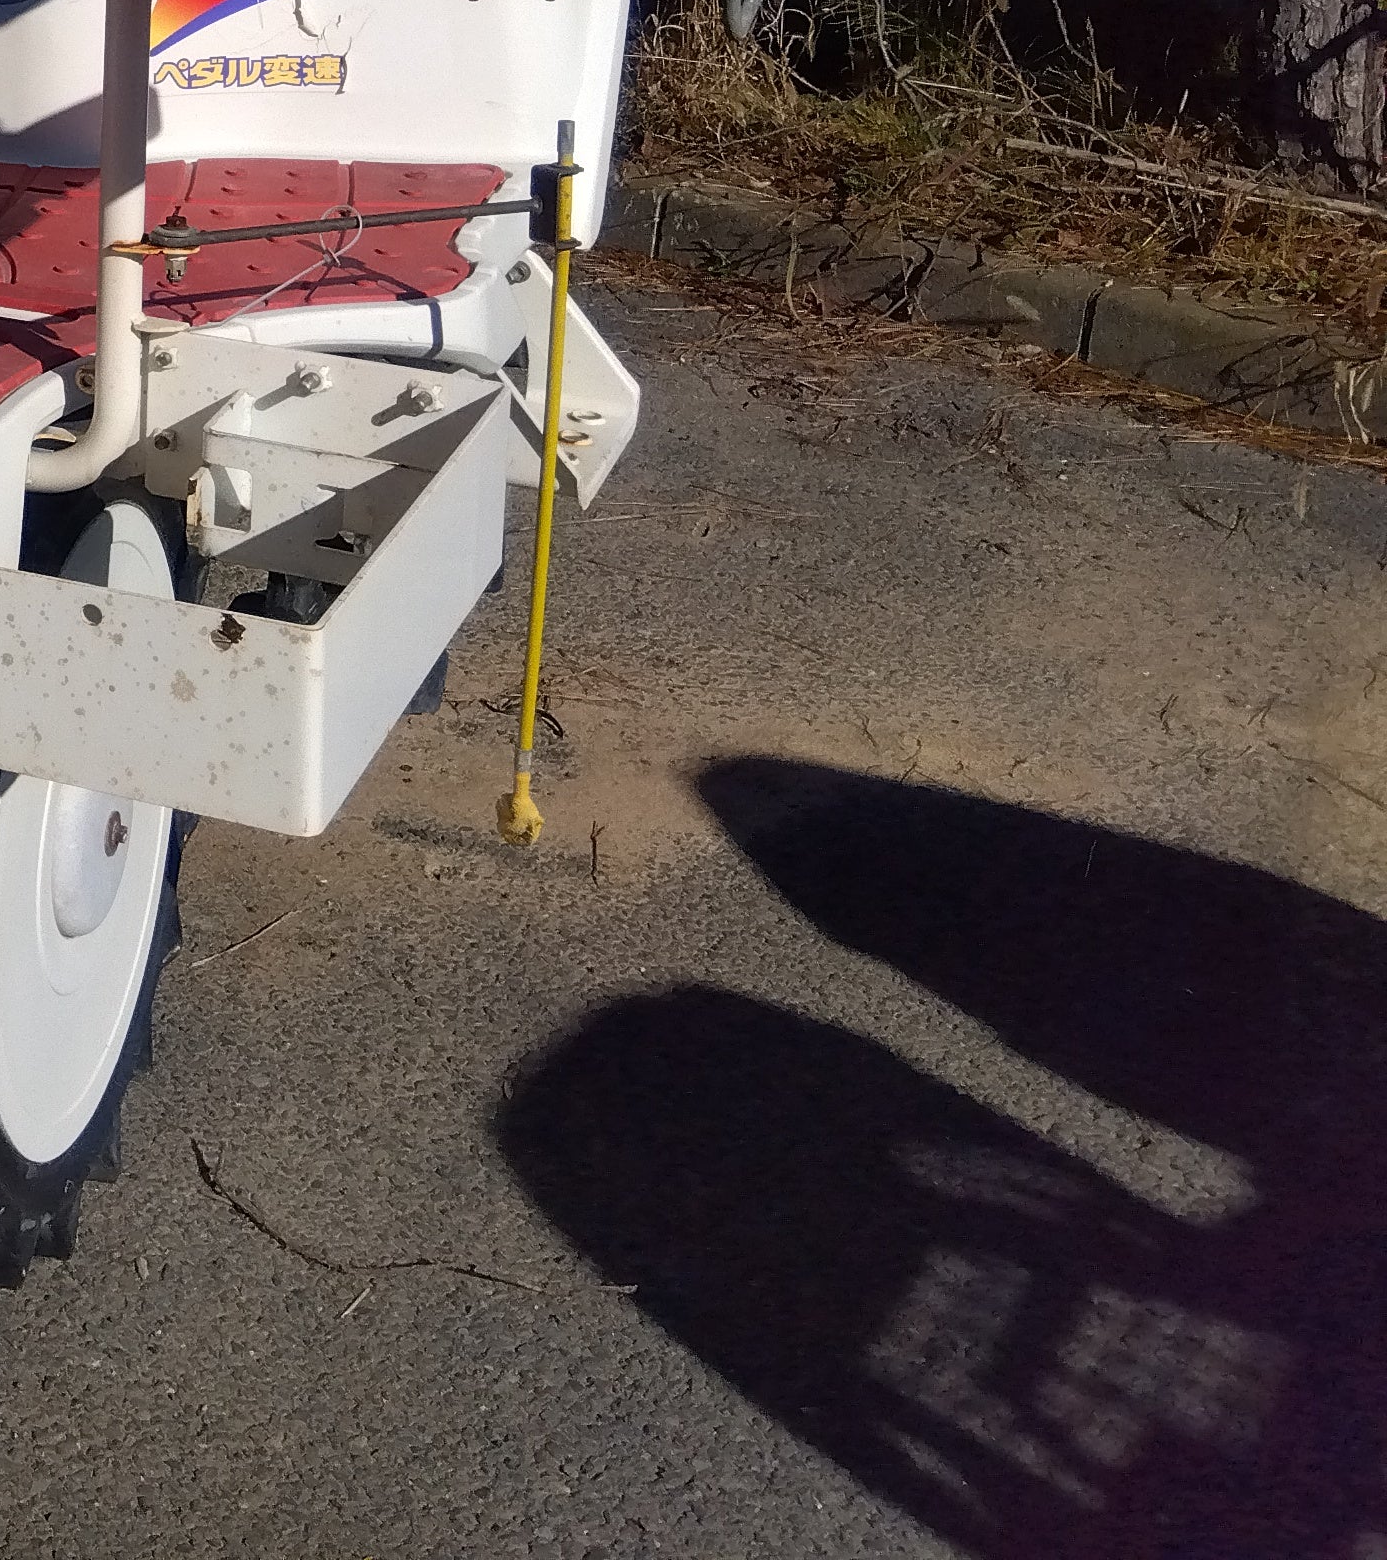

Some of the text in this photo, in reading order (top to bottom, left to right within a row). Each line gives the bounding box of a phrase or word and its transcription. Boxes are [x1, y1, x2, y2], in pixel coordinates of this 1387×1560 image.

[154, 54, 343, 89] ペダル変速
